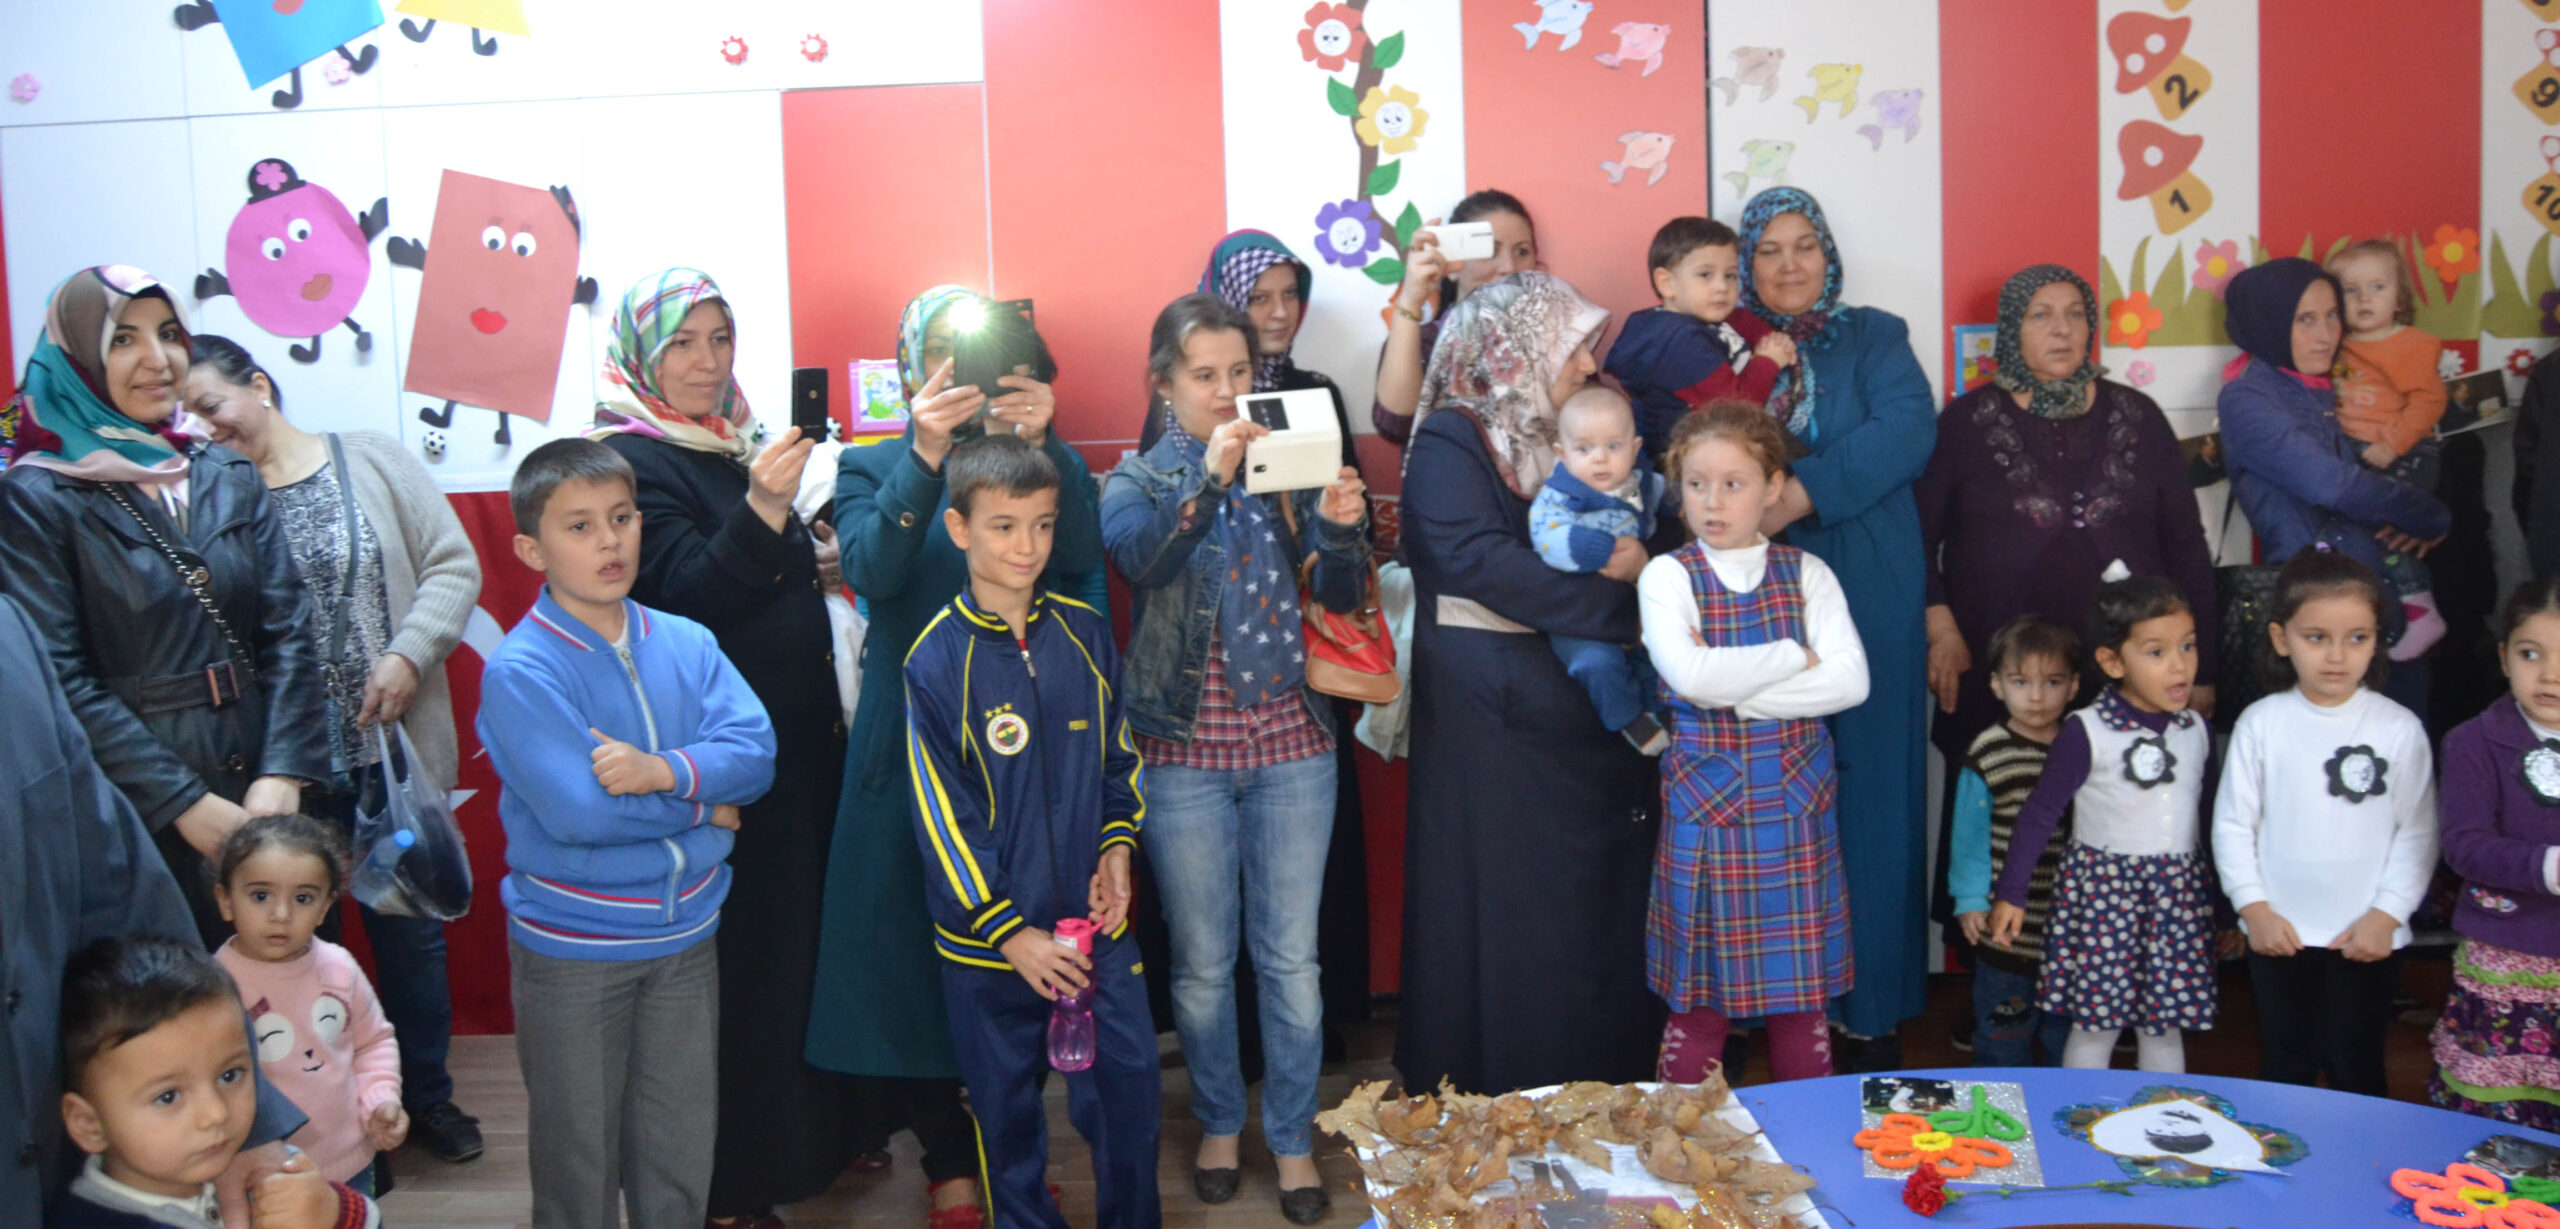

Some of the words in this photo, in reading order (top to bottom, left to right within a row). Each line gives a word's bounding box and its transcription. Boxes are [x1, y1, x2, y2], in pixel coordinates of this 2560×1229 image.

[2164, 74, 2200, 110] 2
[2531, 77, 2560, 108] 9
[2169, 189, 2191, 214] 1
